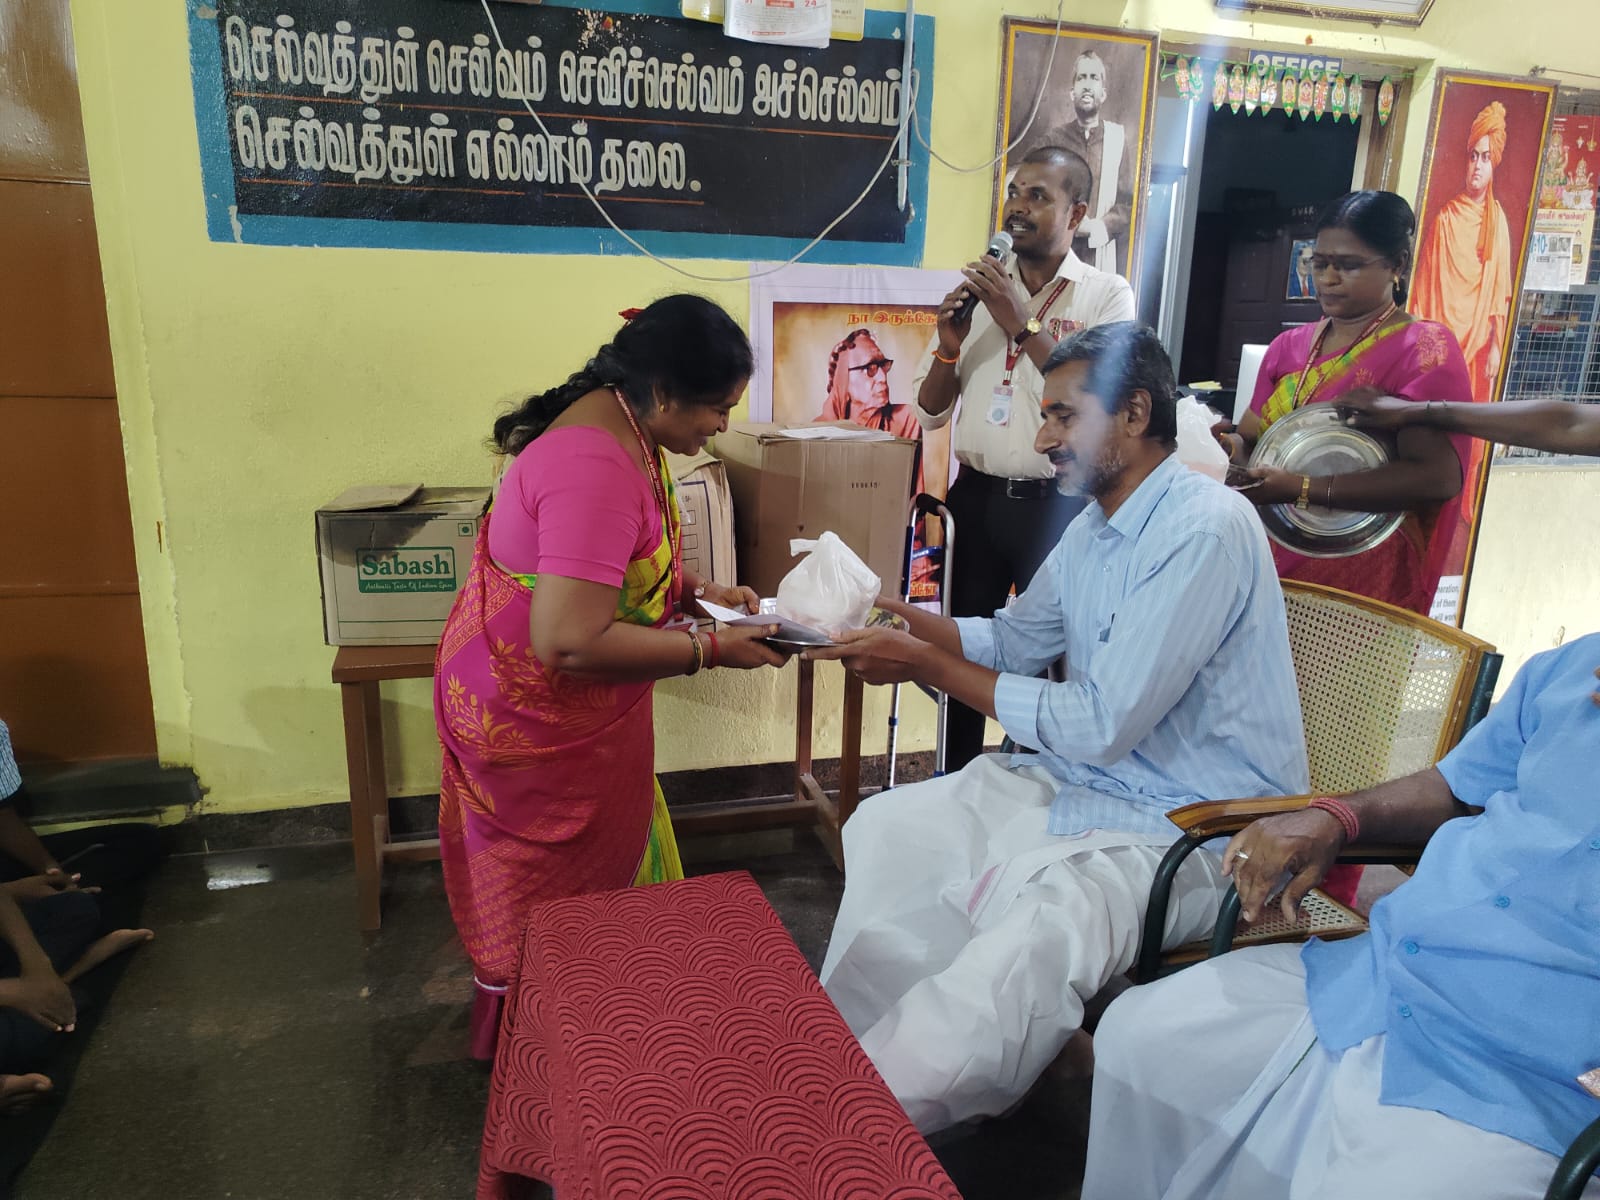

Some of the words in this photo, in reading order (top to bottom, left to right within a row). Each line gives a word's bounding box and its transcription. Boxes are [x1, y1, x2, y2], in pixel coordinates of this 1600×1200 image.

[225, 14, 419, 104] செல்வத்துள்
[427, 33, 547, 102] செல்வம்
[559, 45, 744, 115] செவிச்செல்வம்
[752, 58, 902, 127] அச்செல்வம்
[1252, 54, 1340, 83] OFFICE
[235, 105, 458, 185] செல்வத்துள்
[466, 117, 592, 184] எல்லாம்
[595, 137, 702, 195] தலை.
[872, 309, 938, 326] இருக்கே
[362, 553, 450, 576] Sabash
